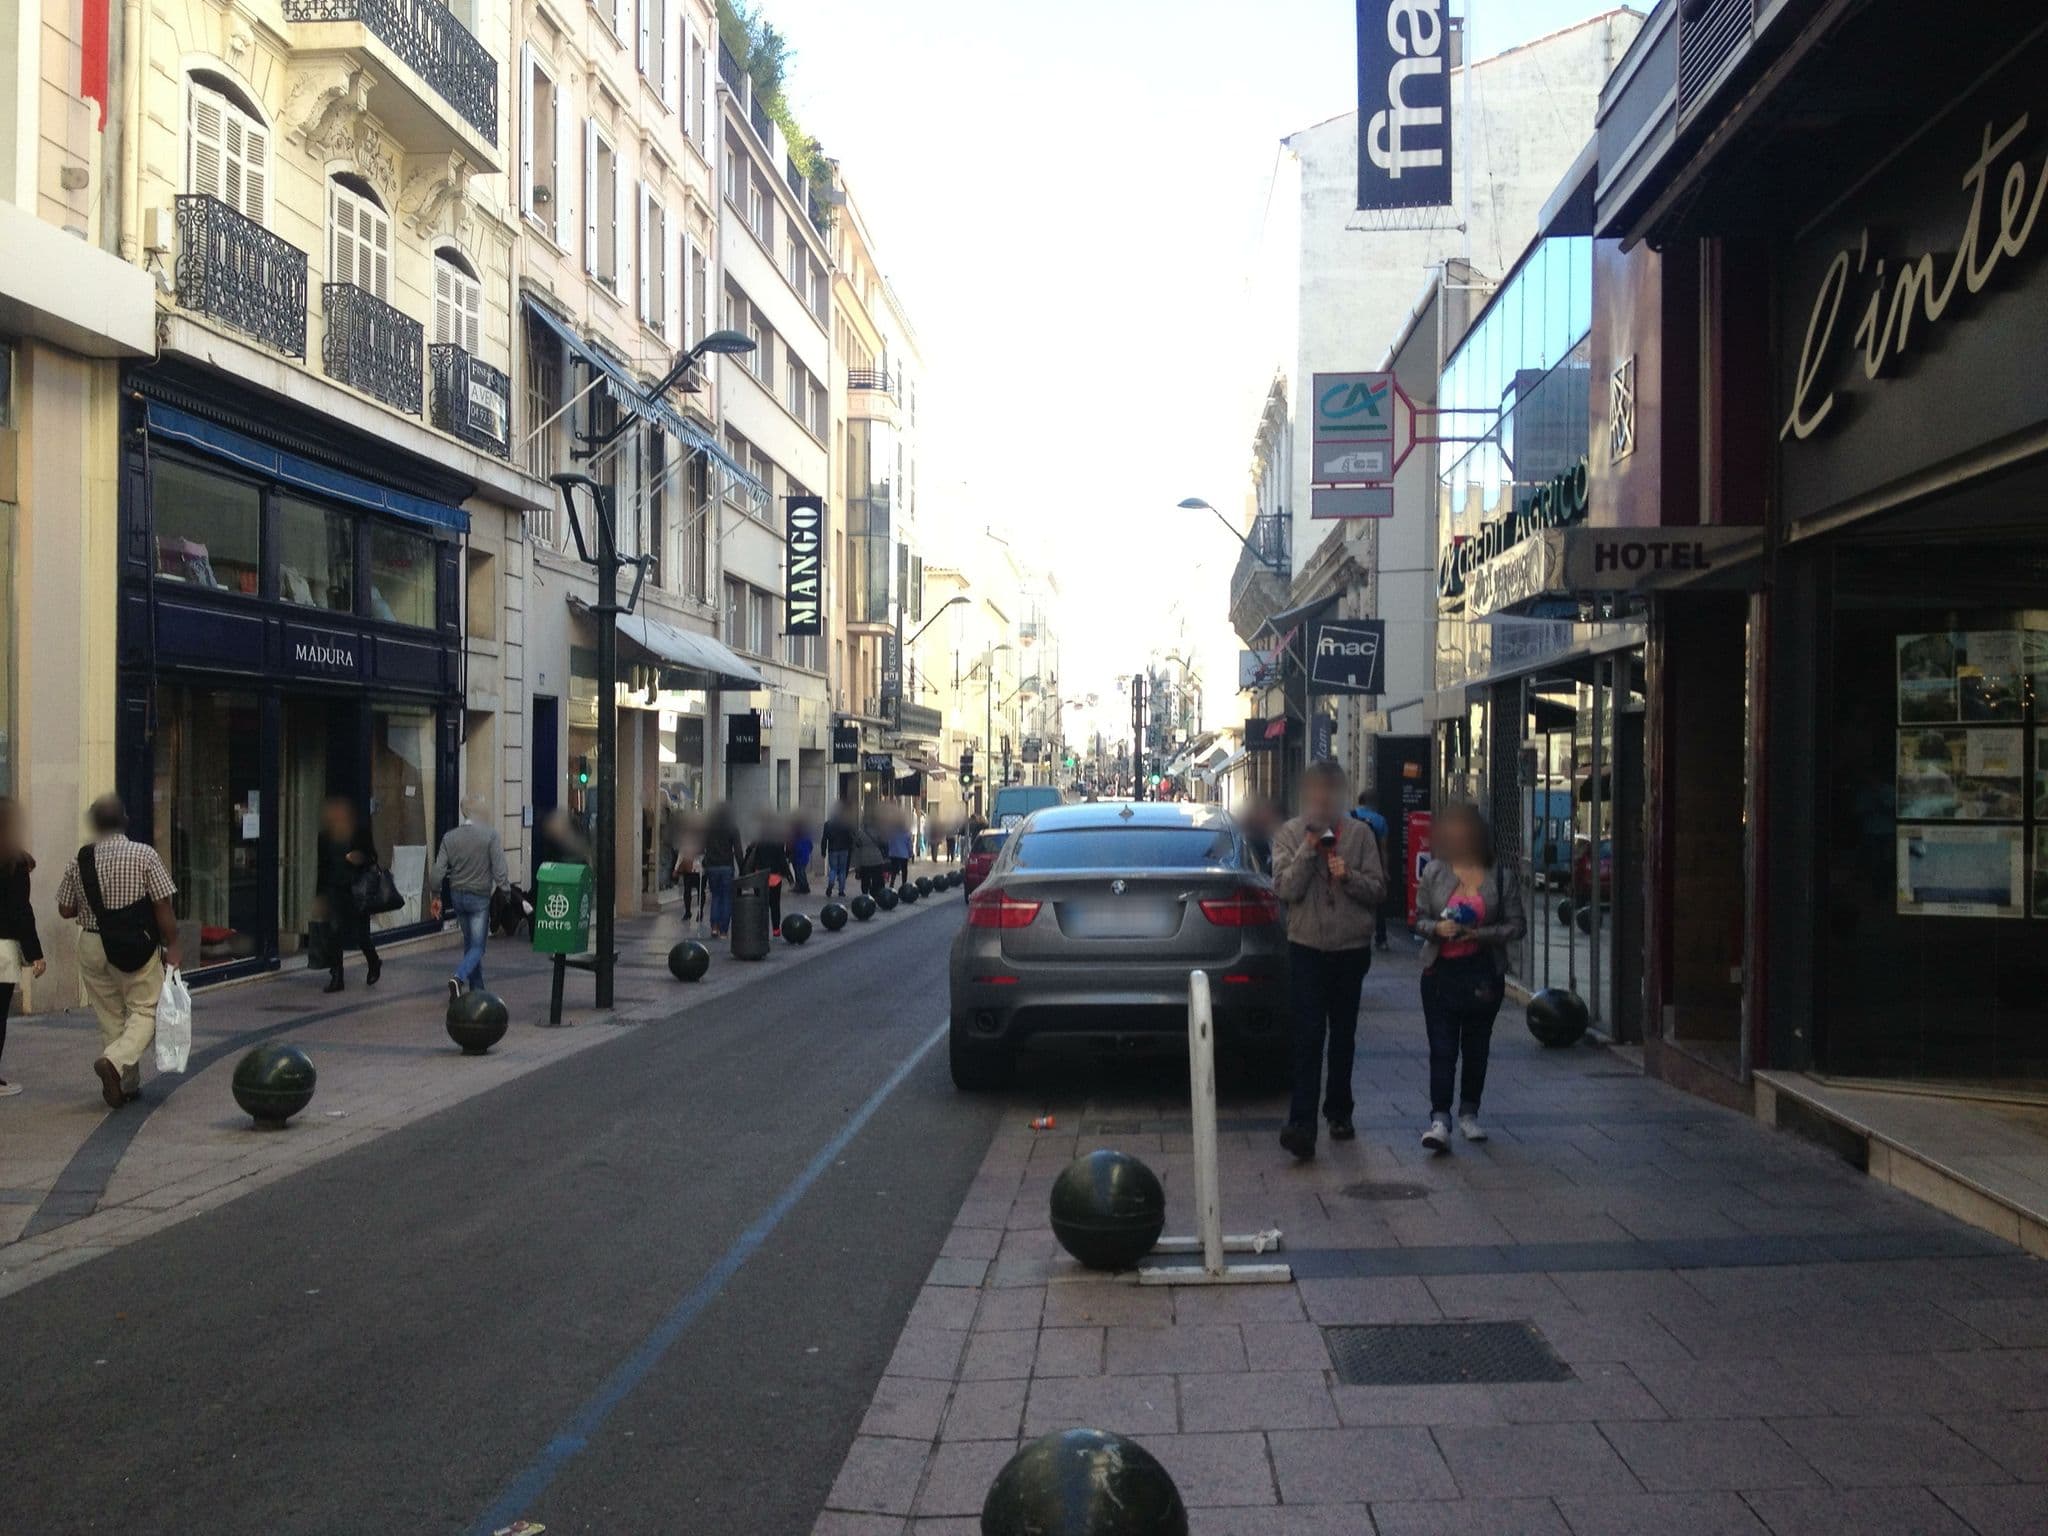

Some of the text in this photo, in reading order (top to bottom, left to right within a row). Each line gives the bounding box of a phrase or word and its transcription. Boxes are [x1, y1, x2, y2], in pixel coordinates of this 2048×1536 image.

[791, 507, 818, 624] MANGO
[1595, 542, 1712, 573] HOTEL
[296, 644, 354, 667] MADURA
[1320, 637, 1376, 656] fnac
